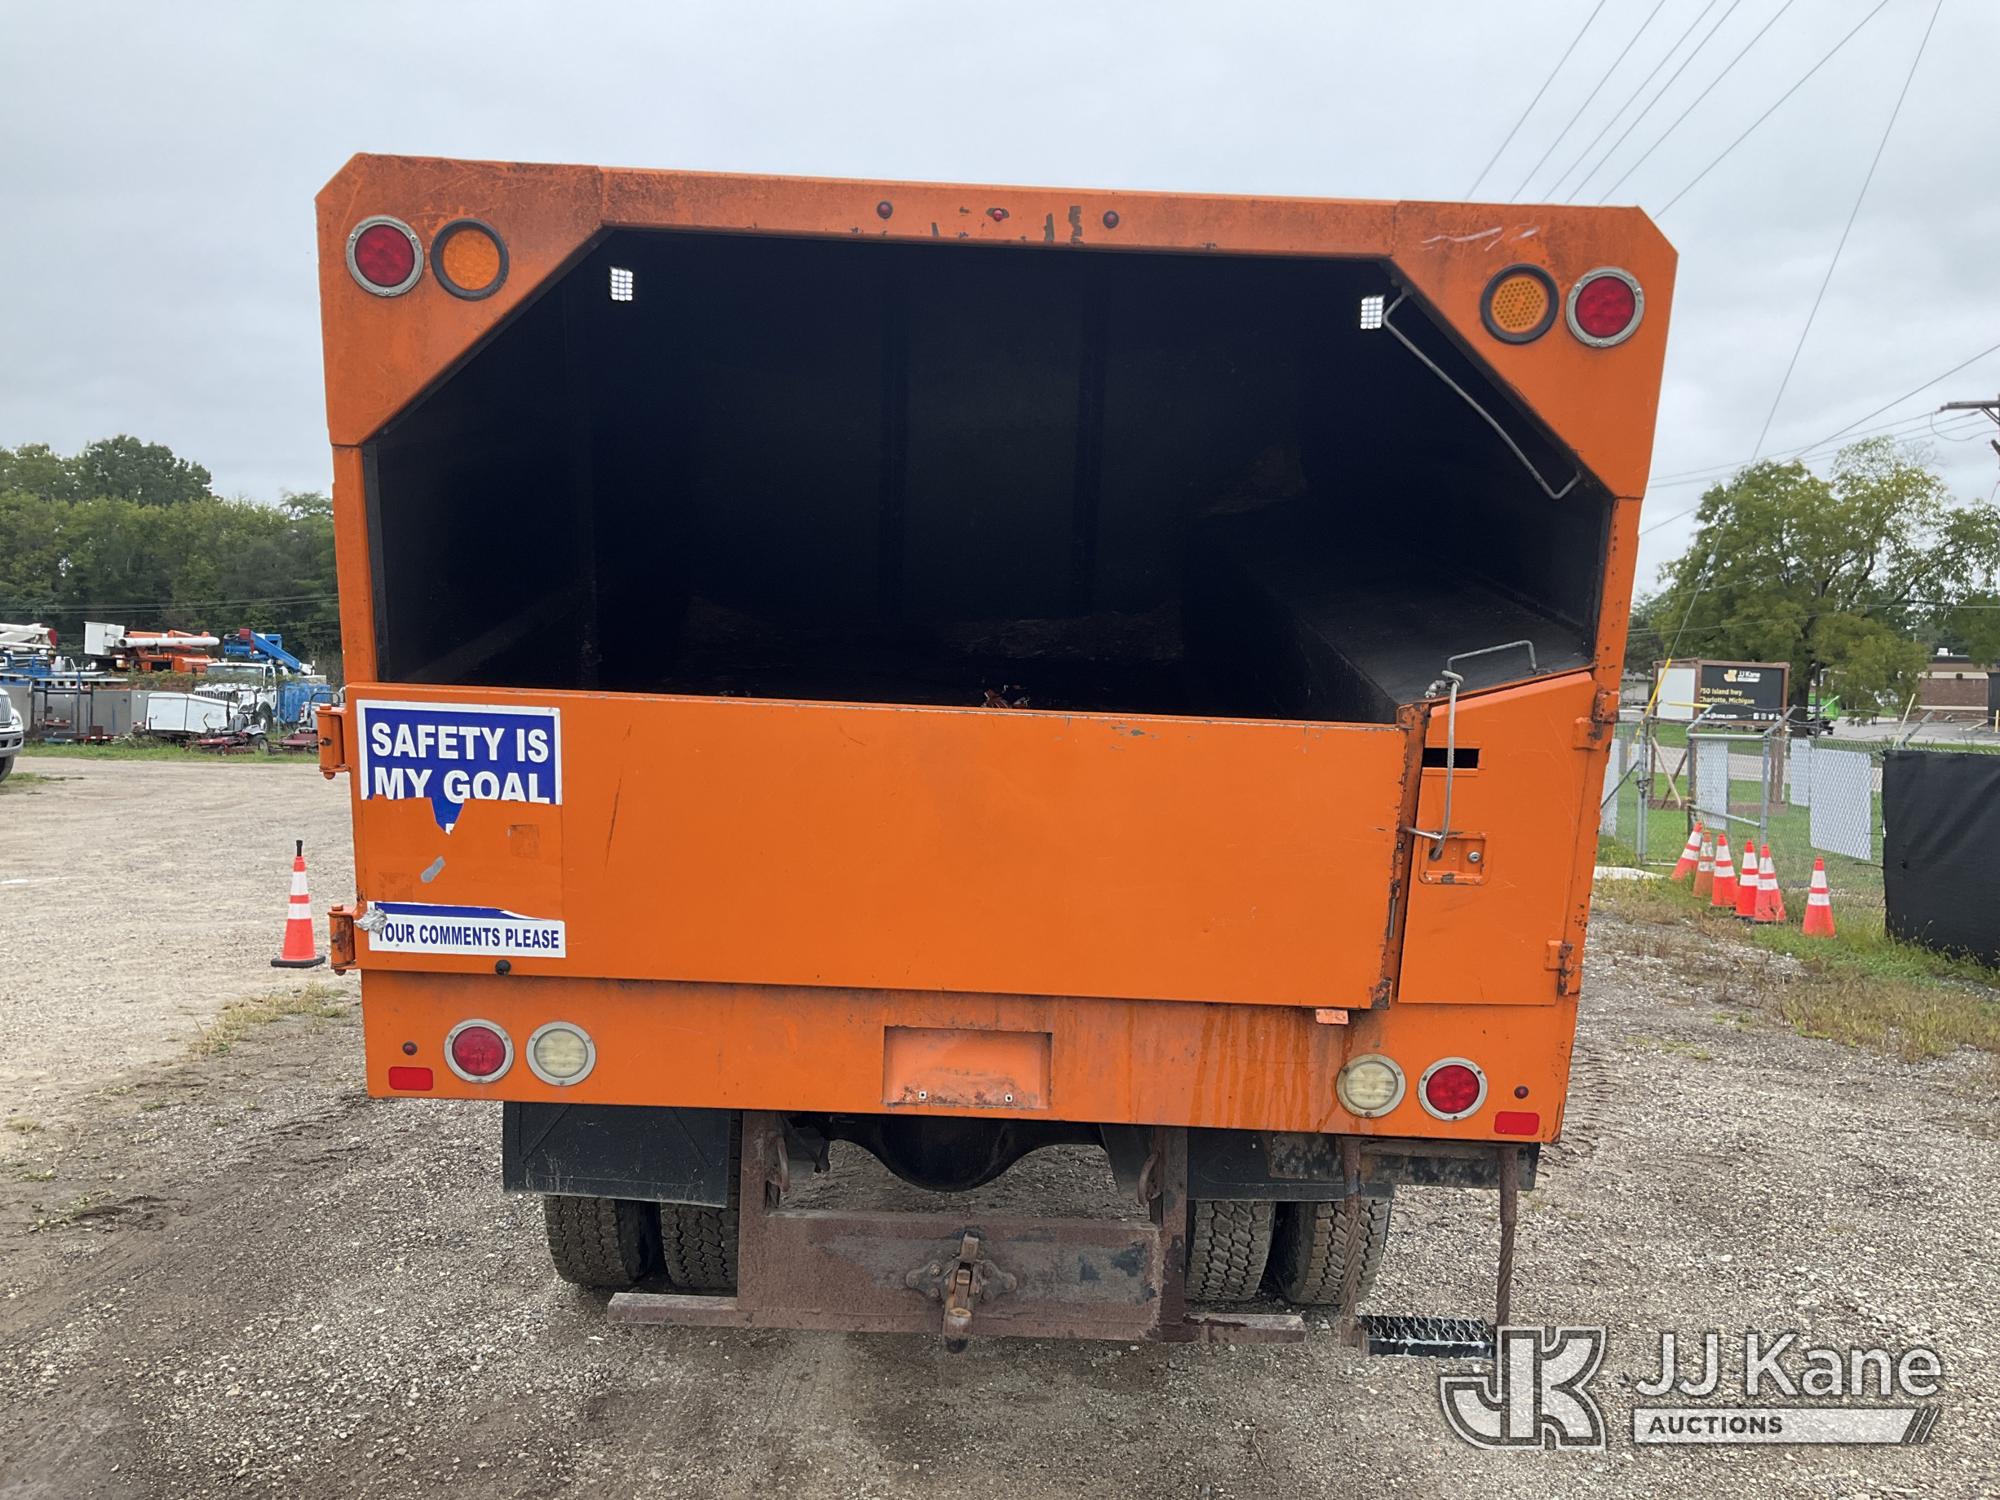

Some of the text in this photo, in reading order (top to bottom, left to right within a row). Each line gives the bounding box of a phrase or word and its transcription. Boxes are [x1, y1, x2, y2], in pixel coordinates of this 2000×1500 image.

[1729, 697, 1755, 705] Michigan
[372, 722, 549, 763] SAFETY IS
[374, 766, 551, 804] MY GOAL
[419, 924, 501, 947] COMMENTS
[505, 928, 559, 949] PLEASE
